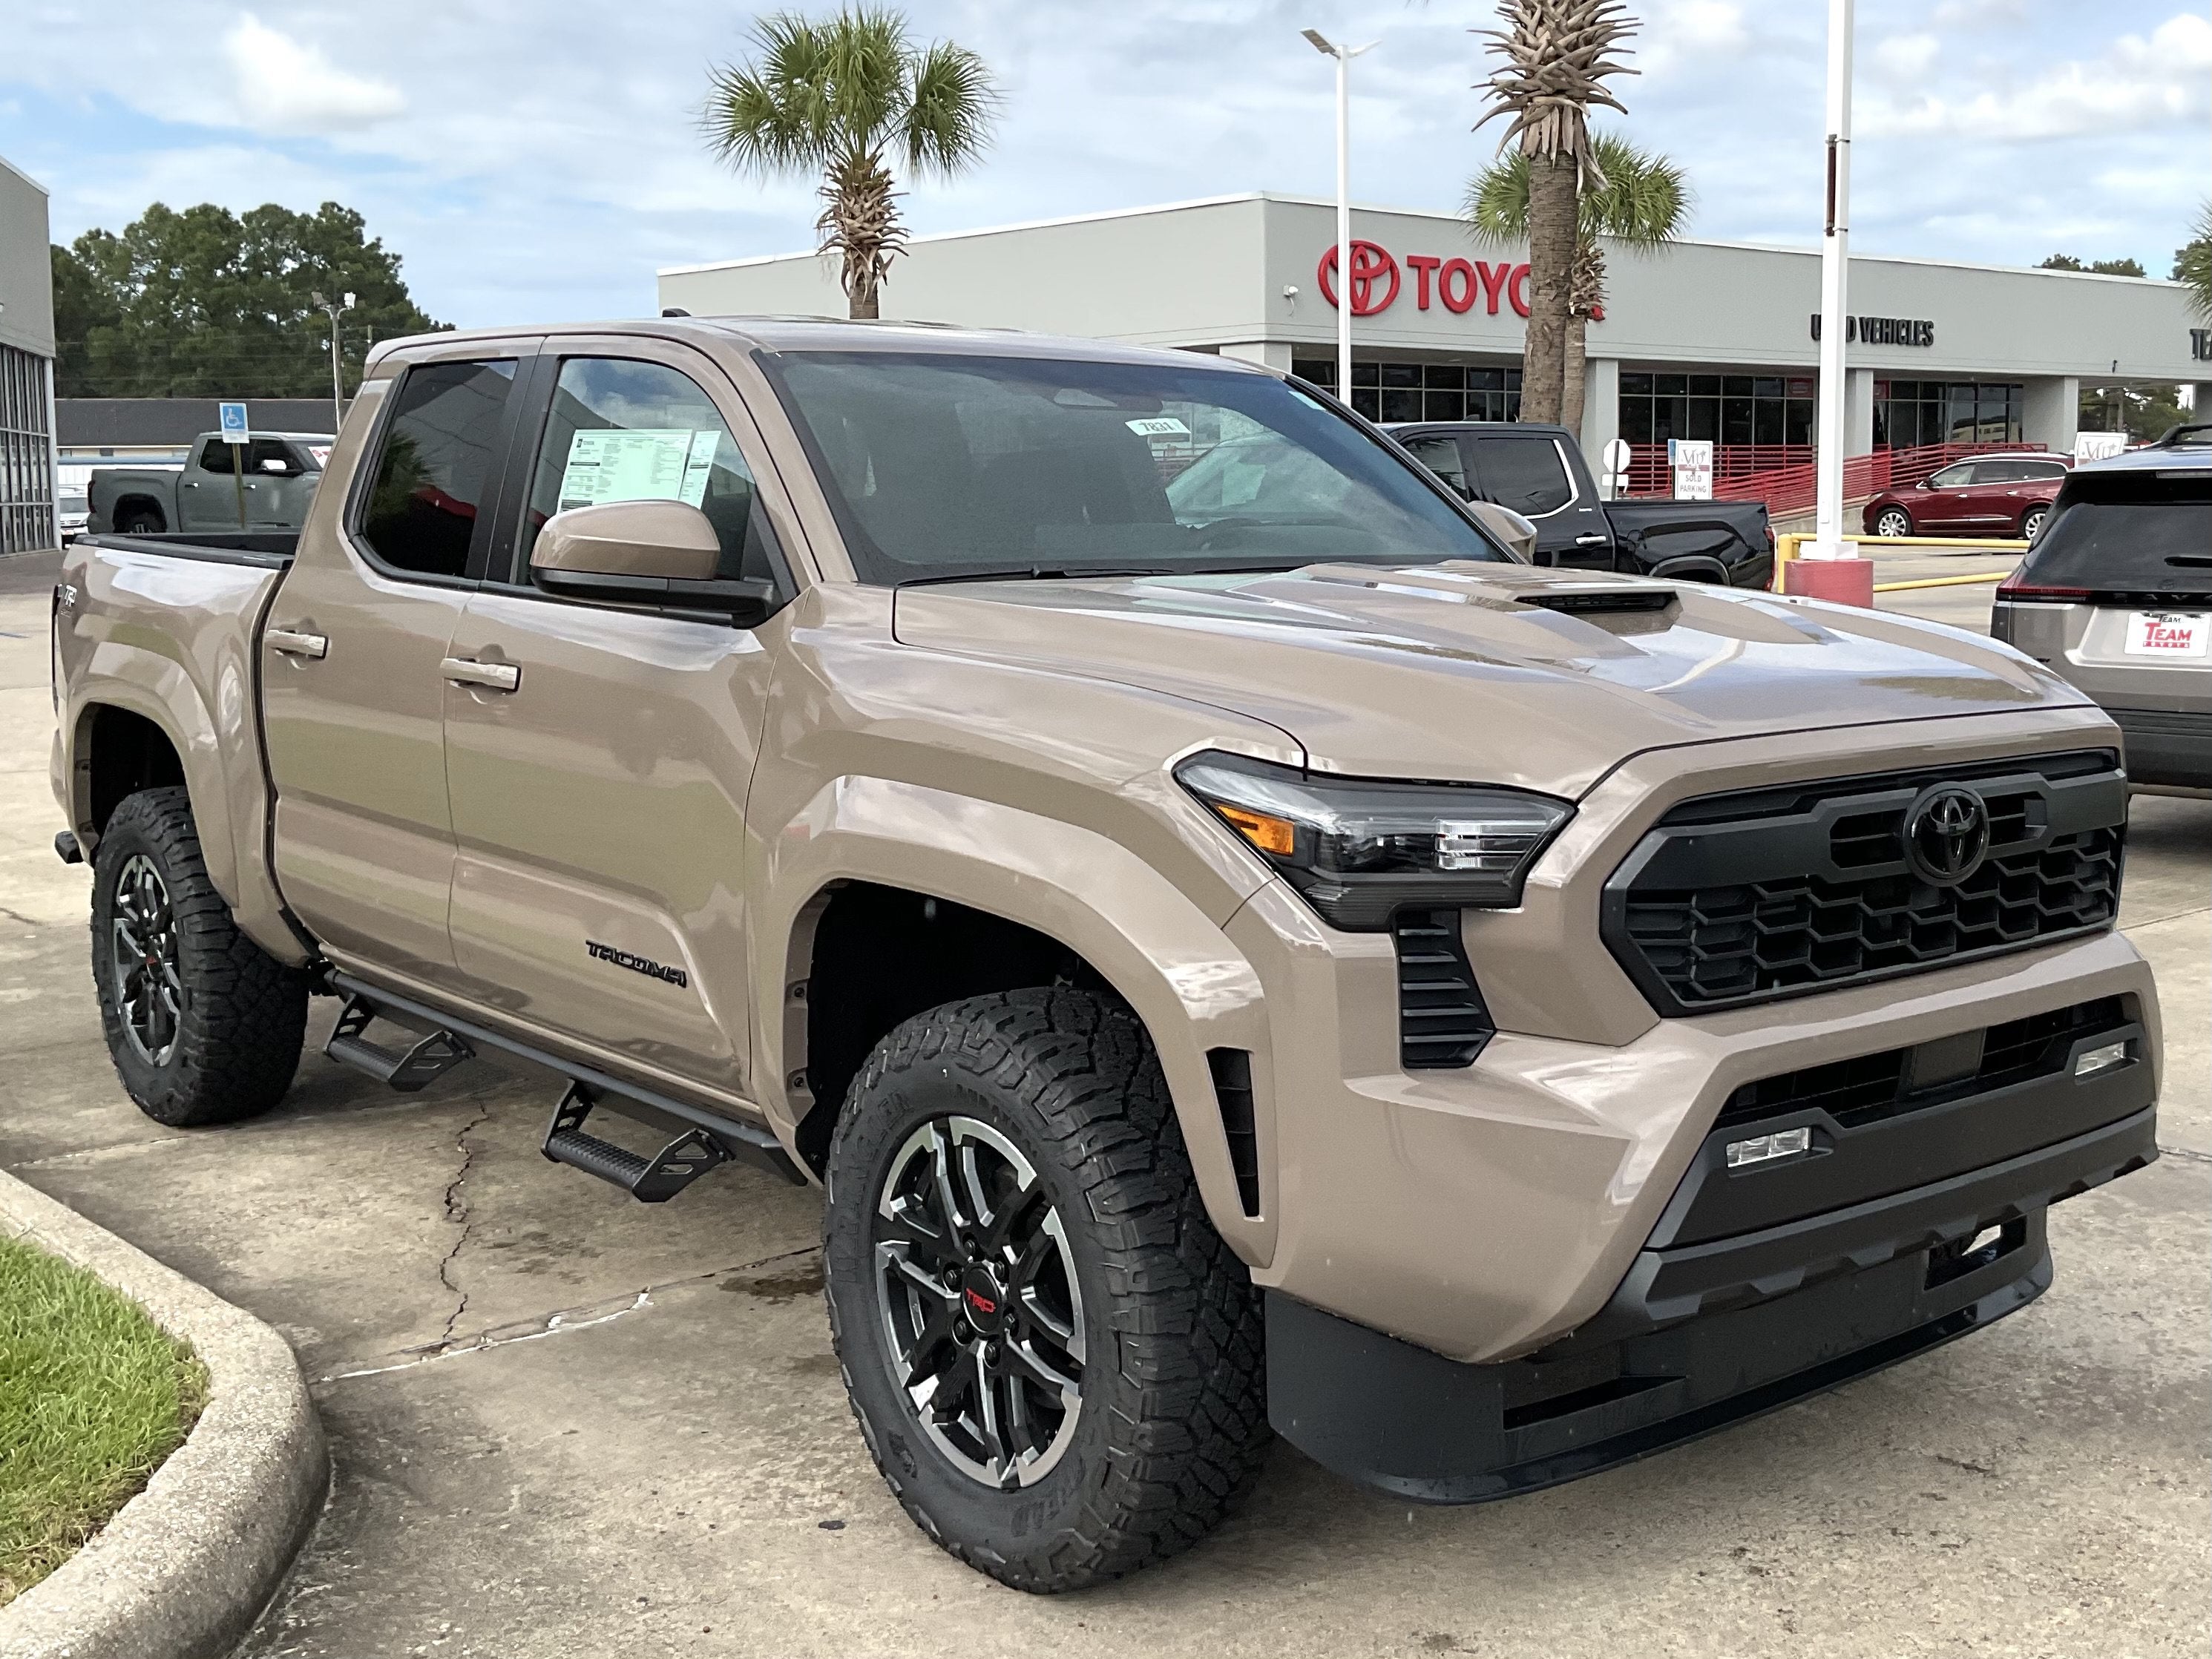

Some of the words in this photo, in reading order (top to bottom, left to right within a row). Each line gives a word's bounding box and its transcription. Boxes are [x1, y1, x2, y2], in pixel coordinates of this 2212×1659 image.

[1406, 255, 1605, 321] TOYO
[1811, 314, 1857, 343] UD
[1859, 317, 1934, 346] VEHICLES
[2144, 622, 2192, 641] TEAM
[2158, 614, 2181, 622] TEAM
[585, 939, 687, 988] TACOMA
